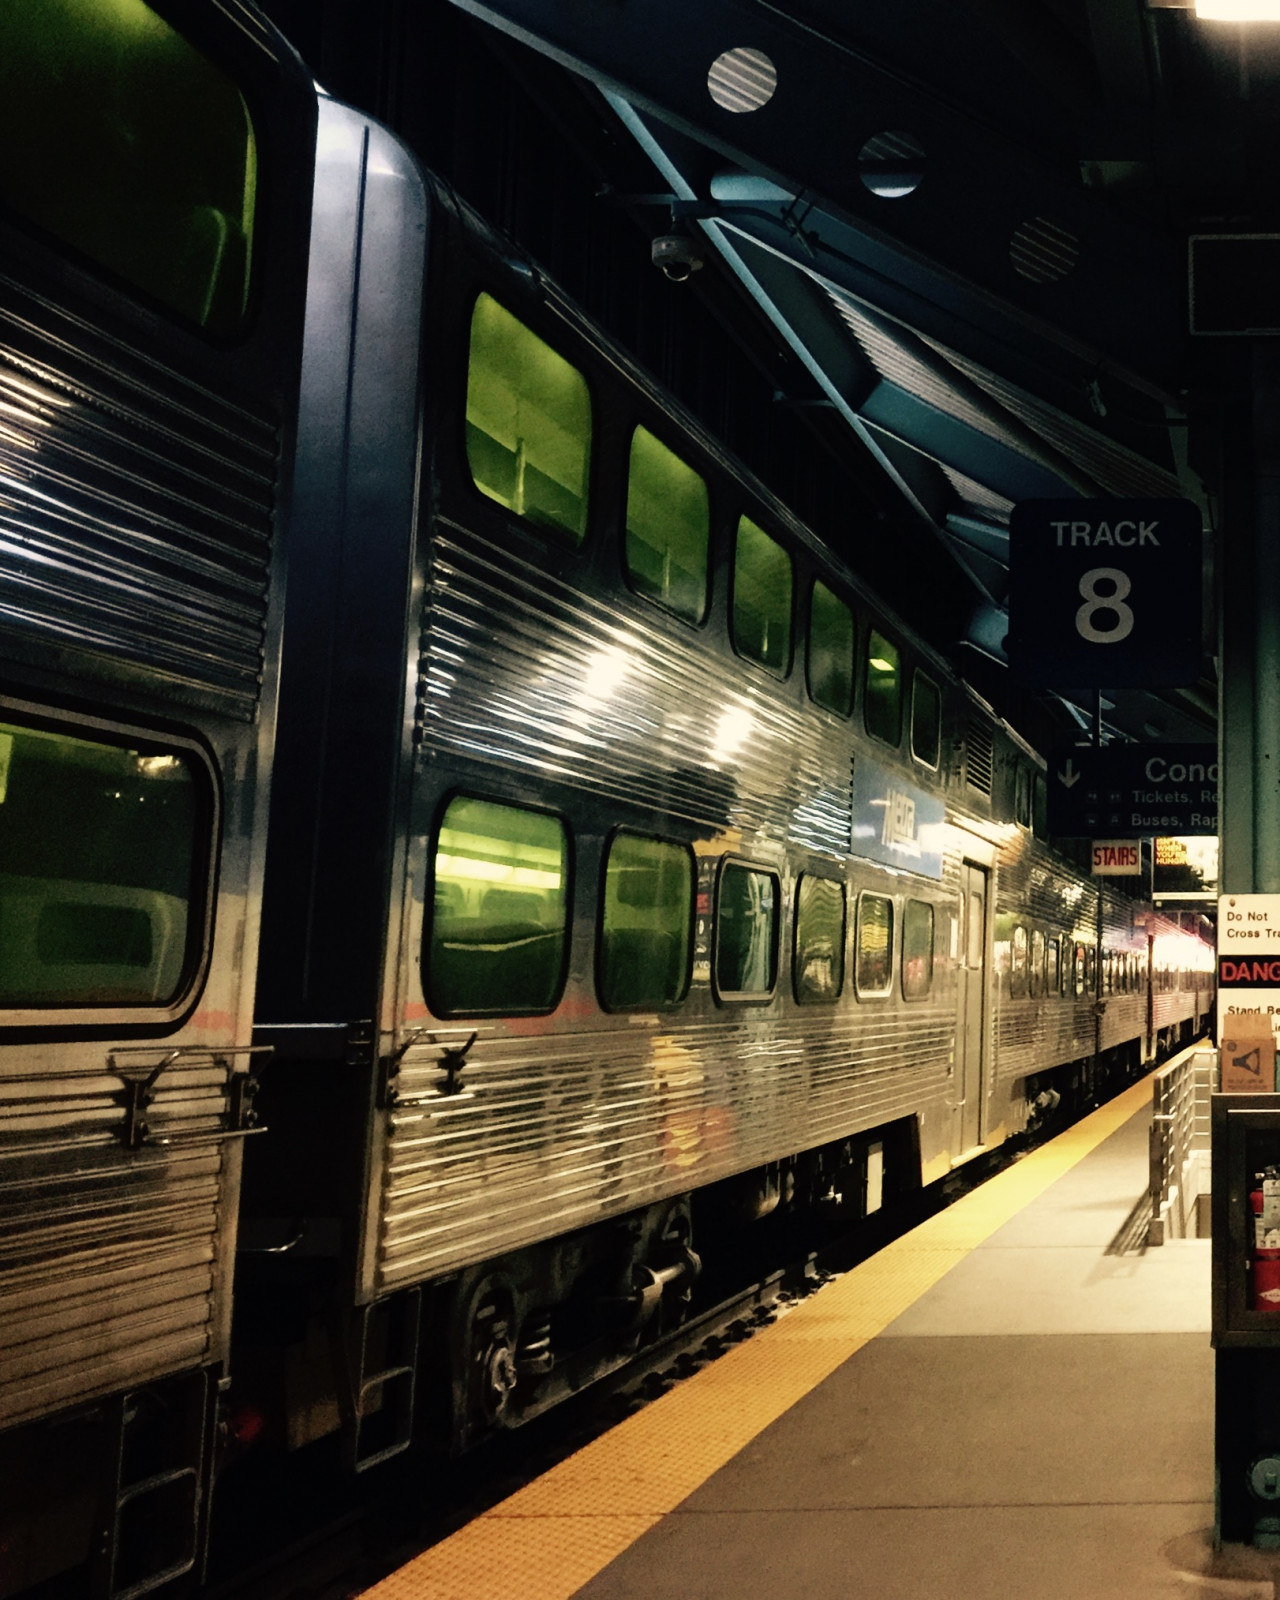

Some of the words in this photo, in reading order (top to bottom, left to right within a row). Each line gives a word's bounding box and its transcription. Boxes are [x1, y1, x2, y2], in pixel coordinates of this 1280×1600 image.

[1050, 521, 1161, 547] TRACK
[1075, 567, 1135, 644] 8
[1131, 790, 1193, 804] Tickets,
[1131, 813, 1183, 828] Buses,
[1094, 847, 1137, 866] STAIRS
[1227, 912, 1242, 921] Do
[1248, 912, 1268, 921] Not
[1227, 928, 1260, 938] Cross
[1228, 1006, 1260, 1015] Stand
